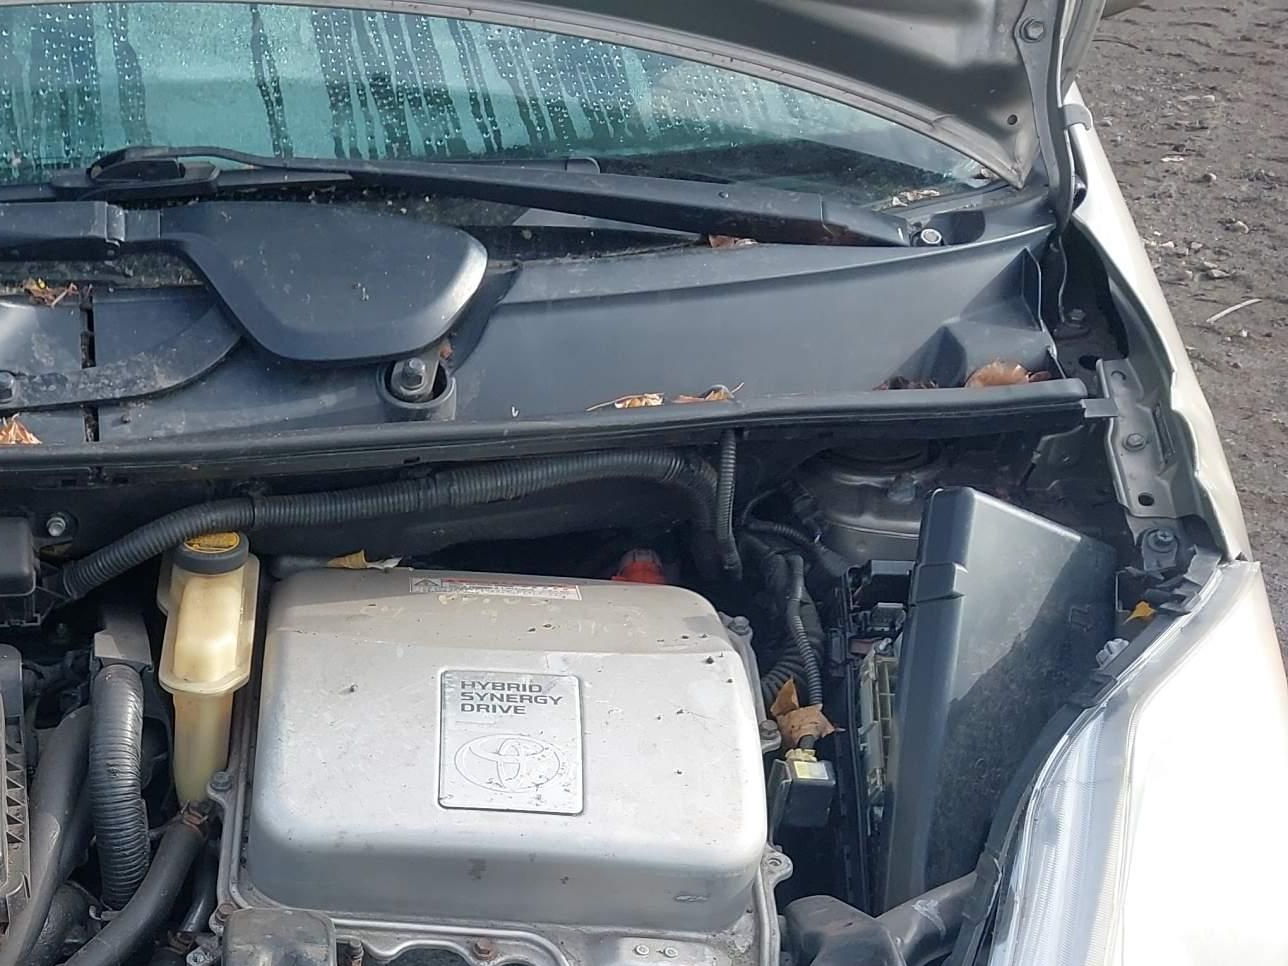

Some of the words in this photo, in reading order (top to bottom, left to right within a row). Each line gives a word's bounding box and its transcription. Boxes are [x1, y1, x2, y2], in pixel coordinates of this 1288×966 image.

[461, 681, 542, 693] HYBRID
[461, 692, 563, 705] SYNERGY
[461, 703, 526, 714] DRIVE
